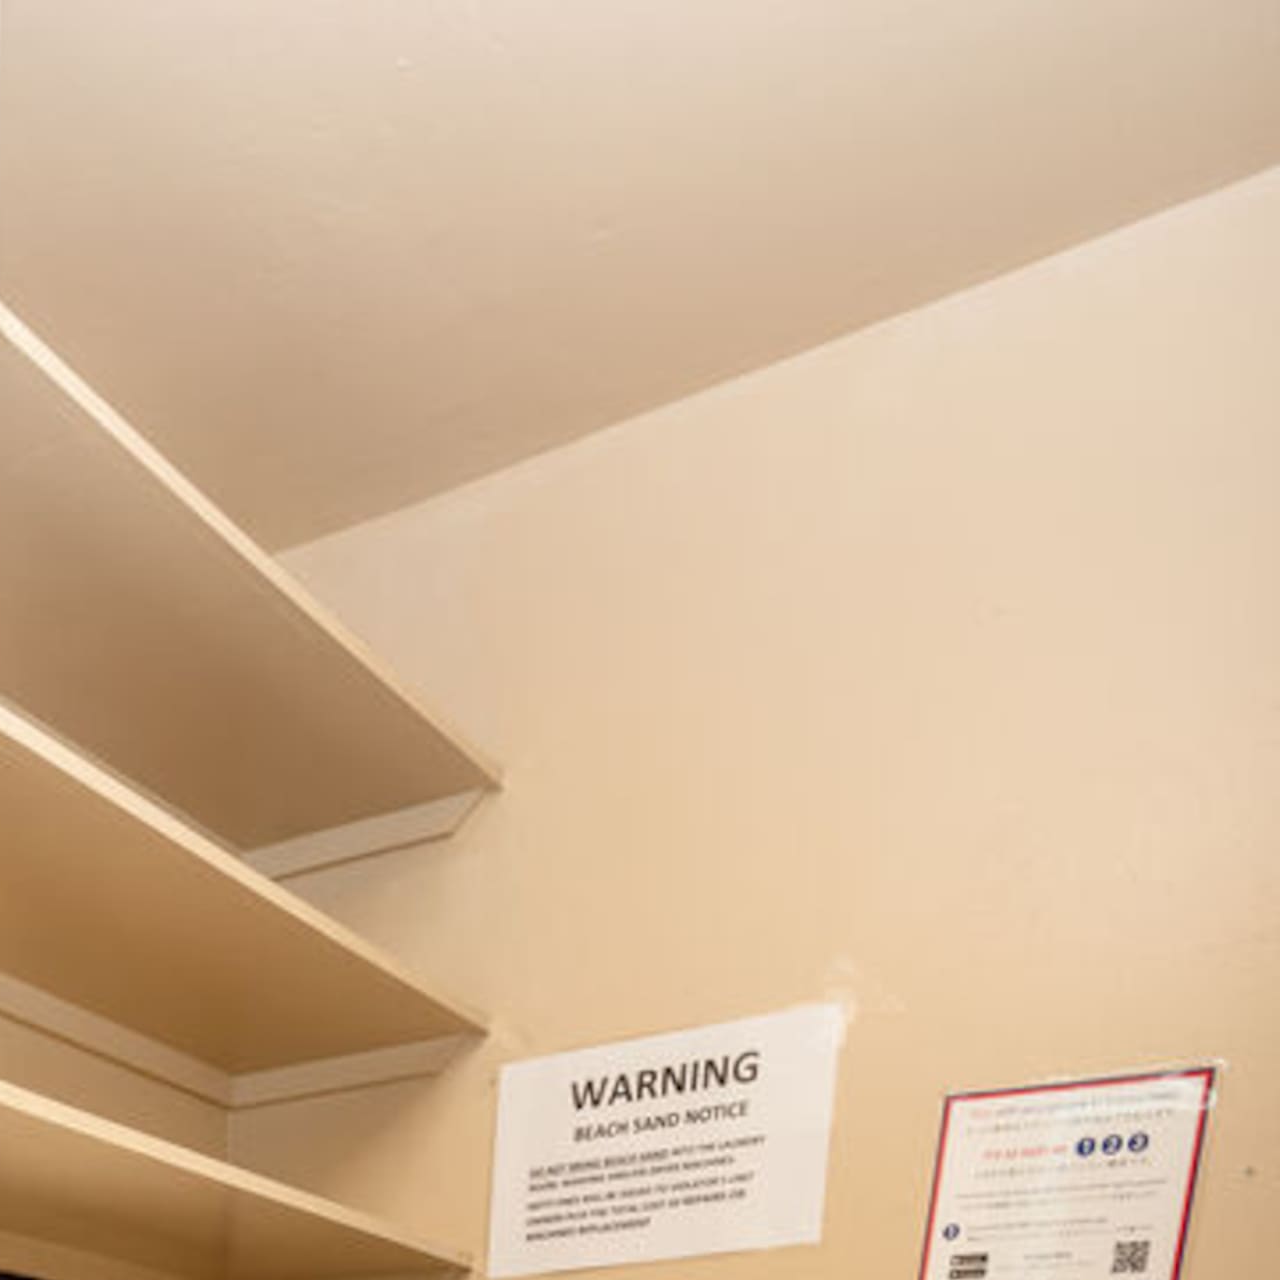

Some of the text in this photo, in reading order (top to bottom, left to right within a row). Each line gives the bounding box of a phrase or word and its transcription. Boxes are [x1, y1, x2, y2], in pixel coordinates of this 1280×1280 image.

[572, 1051, 760, 1110] WARNING
[573, 1099, 749, 1142] BEACH SAND NOTICE
